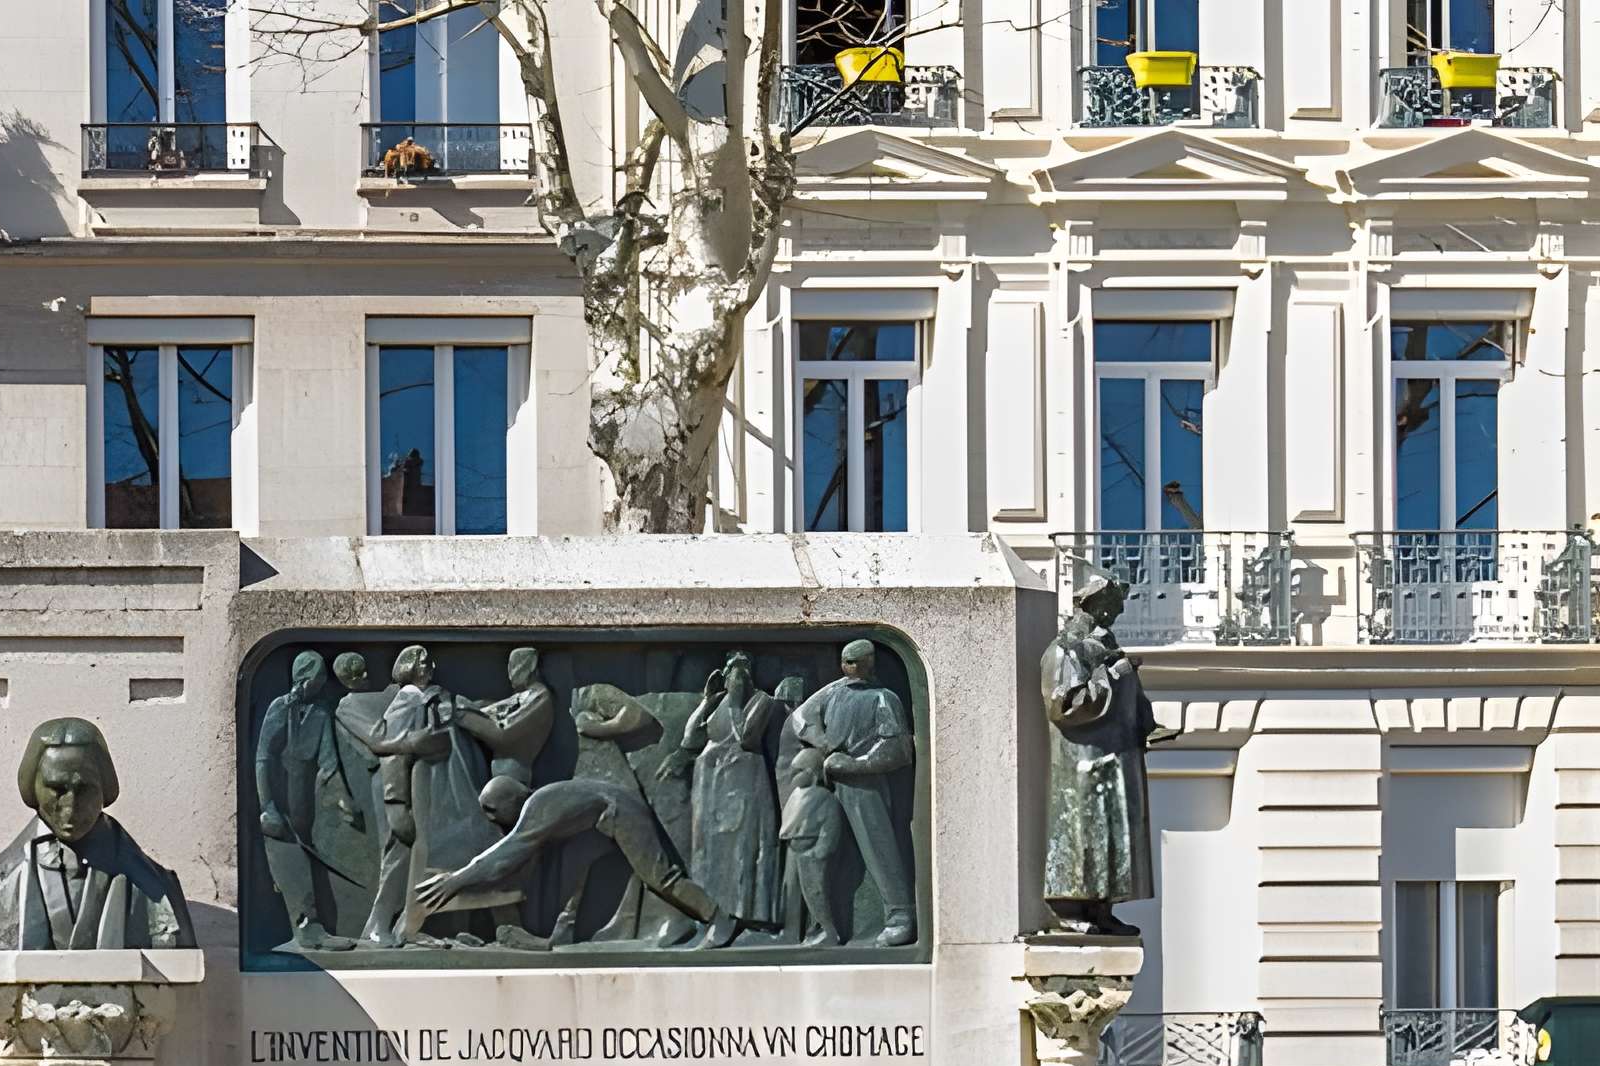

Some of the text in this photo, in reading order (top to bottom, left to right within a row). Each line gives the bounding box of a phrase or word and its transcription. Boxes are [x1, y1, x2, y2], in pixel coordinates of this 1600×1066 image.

[419, 1029, 451, 1060] DE
[602, 1026, 760, 1059] OCCASIONNA
[805, 1025, 925, 1057] CHOMAGE
